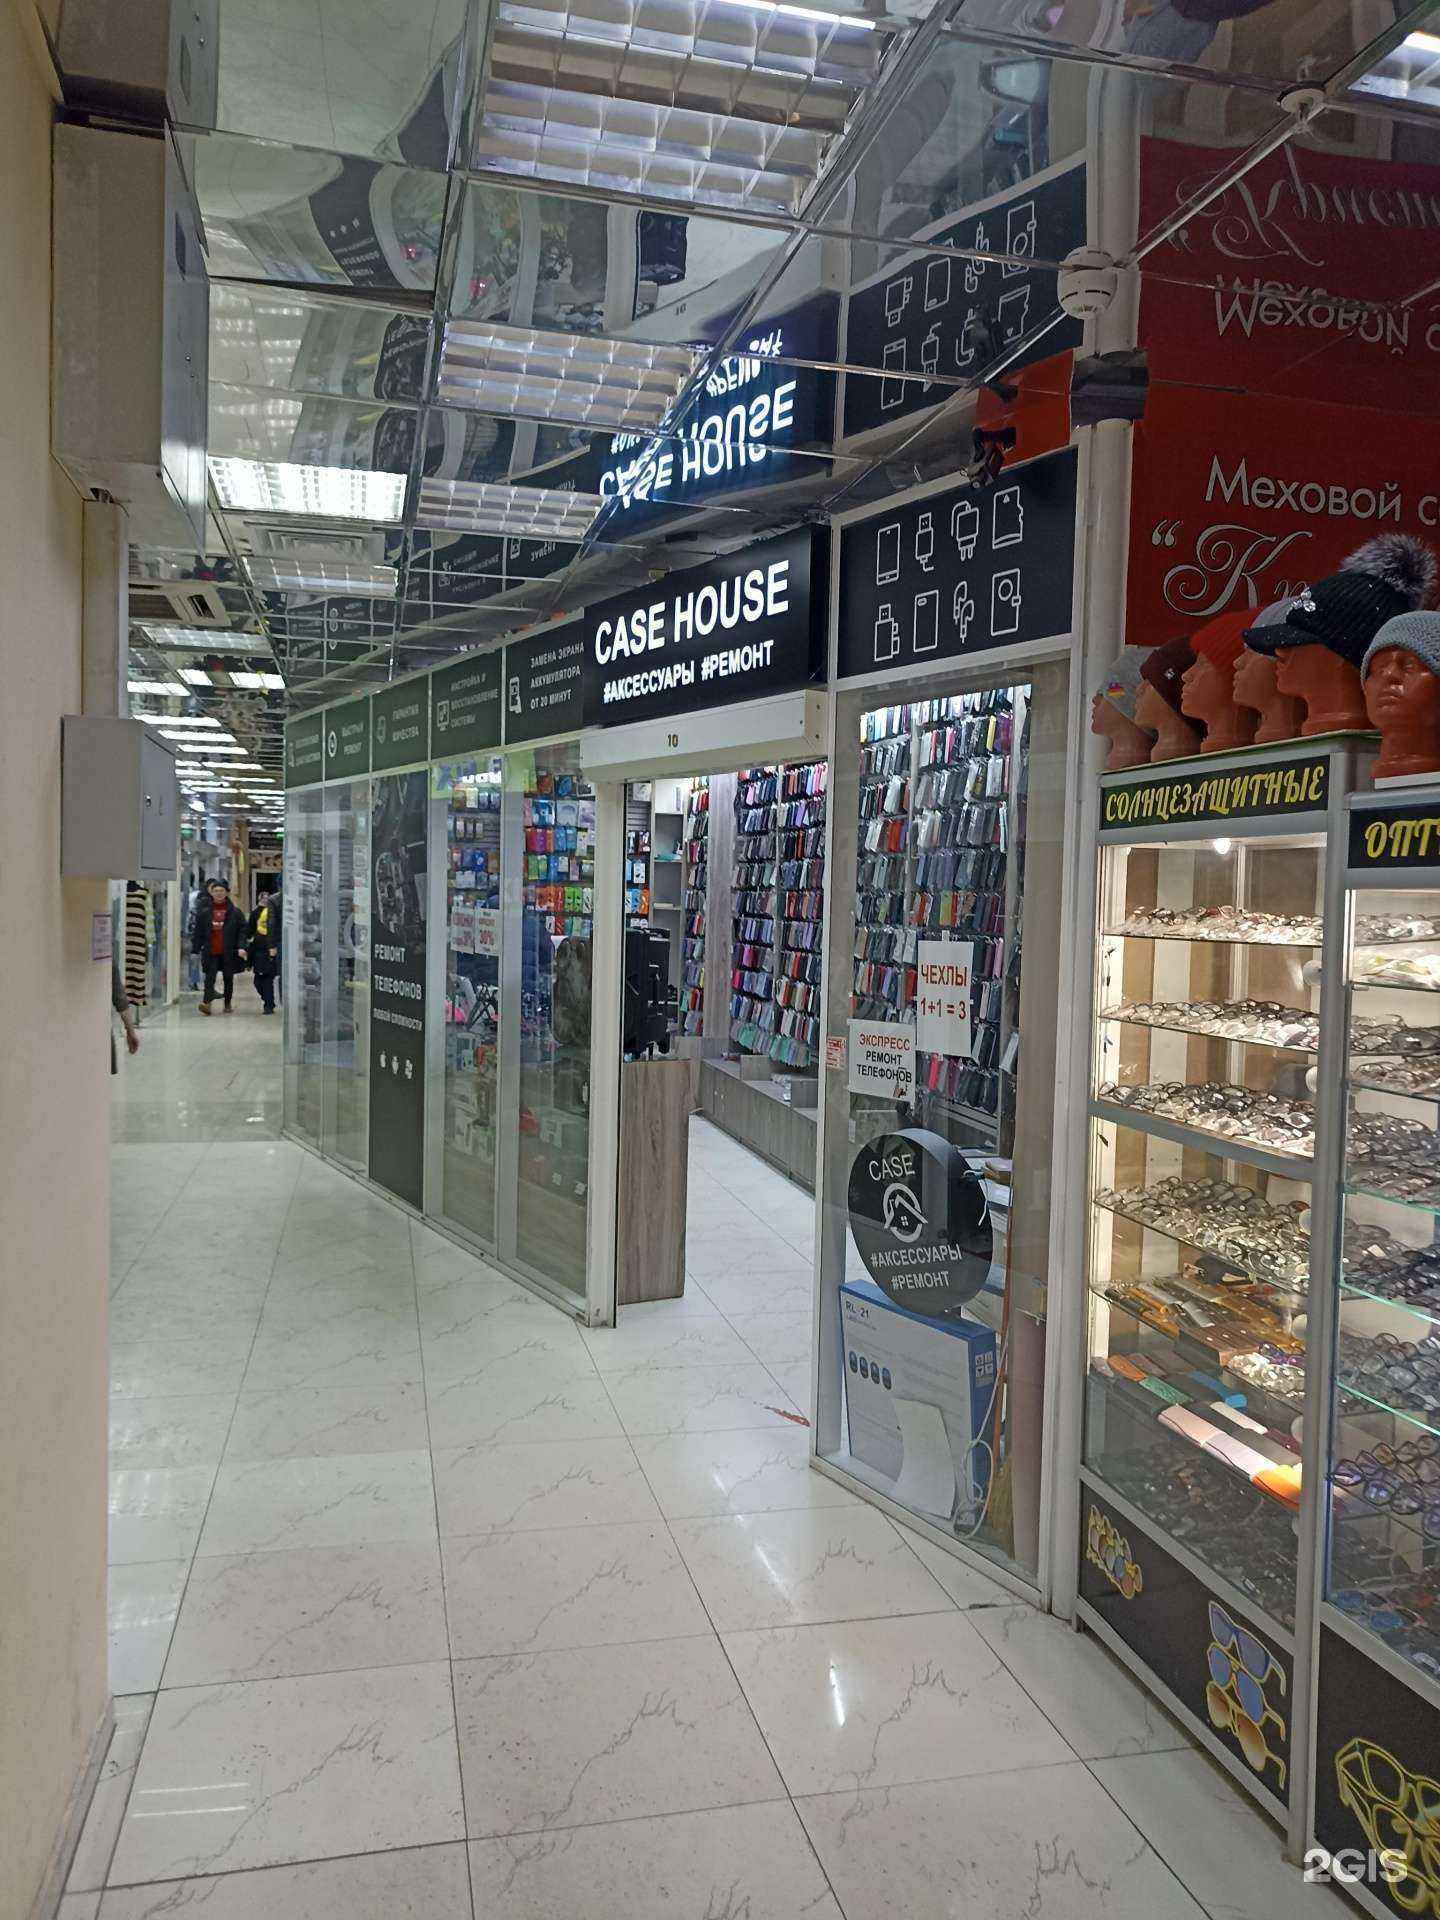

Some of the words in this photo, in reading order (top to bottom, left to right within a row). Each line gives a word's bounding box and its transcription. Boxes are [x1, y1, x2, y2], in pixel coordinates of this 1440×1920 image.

[1205, 454, 1401, 522] Меховой
[1418, 496, 1440, 528] с
[595, 601, 666, 665] CASE
[674, 560, 789, 642] HOUSE
[531, 652, 557, 668] ЗАМЕНА
[558, 642, 585, 660] ЭКРАНА
[530, 665, 581, 689] АККУМУЛЯТОРА
[603, 660, 695, 704] #АКСЕССУАРЫ
[701, 639, 774, 681] #РЕМОНТ
[530, 698, 540, 710] ОТ
[541, 695, 548, 707] 20
[549, 689, 572, 705] МИНУТ
[667, 734, 679, 748] 10
[1105, 765, 1325, 822] СОЛНЦЕЗАЩИТНЫЕ
[374, 943, 406, 963] РЕМОНТ
[374, 974, 422, 1000] ТЕЛЕФОНОВ
[921, 964, 968, 988] ЧЕХЛЫ
[859, 1033, 911, 1052] ЭКСПРЕСС
[865, 1051, 903, 1066] РЕМОНТ
[857, 1064, 912, 1084] ТЕЛЕФОНОВ
[869, 1154, 916, 1182] CASE
[870, 1243, 963, 1268] #АКСЕССУАРЫ
[891, 1271, 951, 1291] #РЕМОНТ
